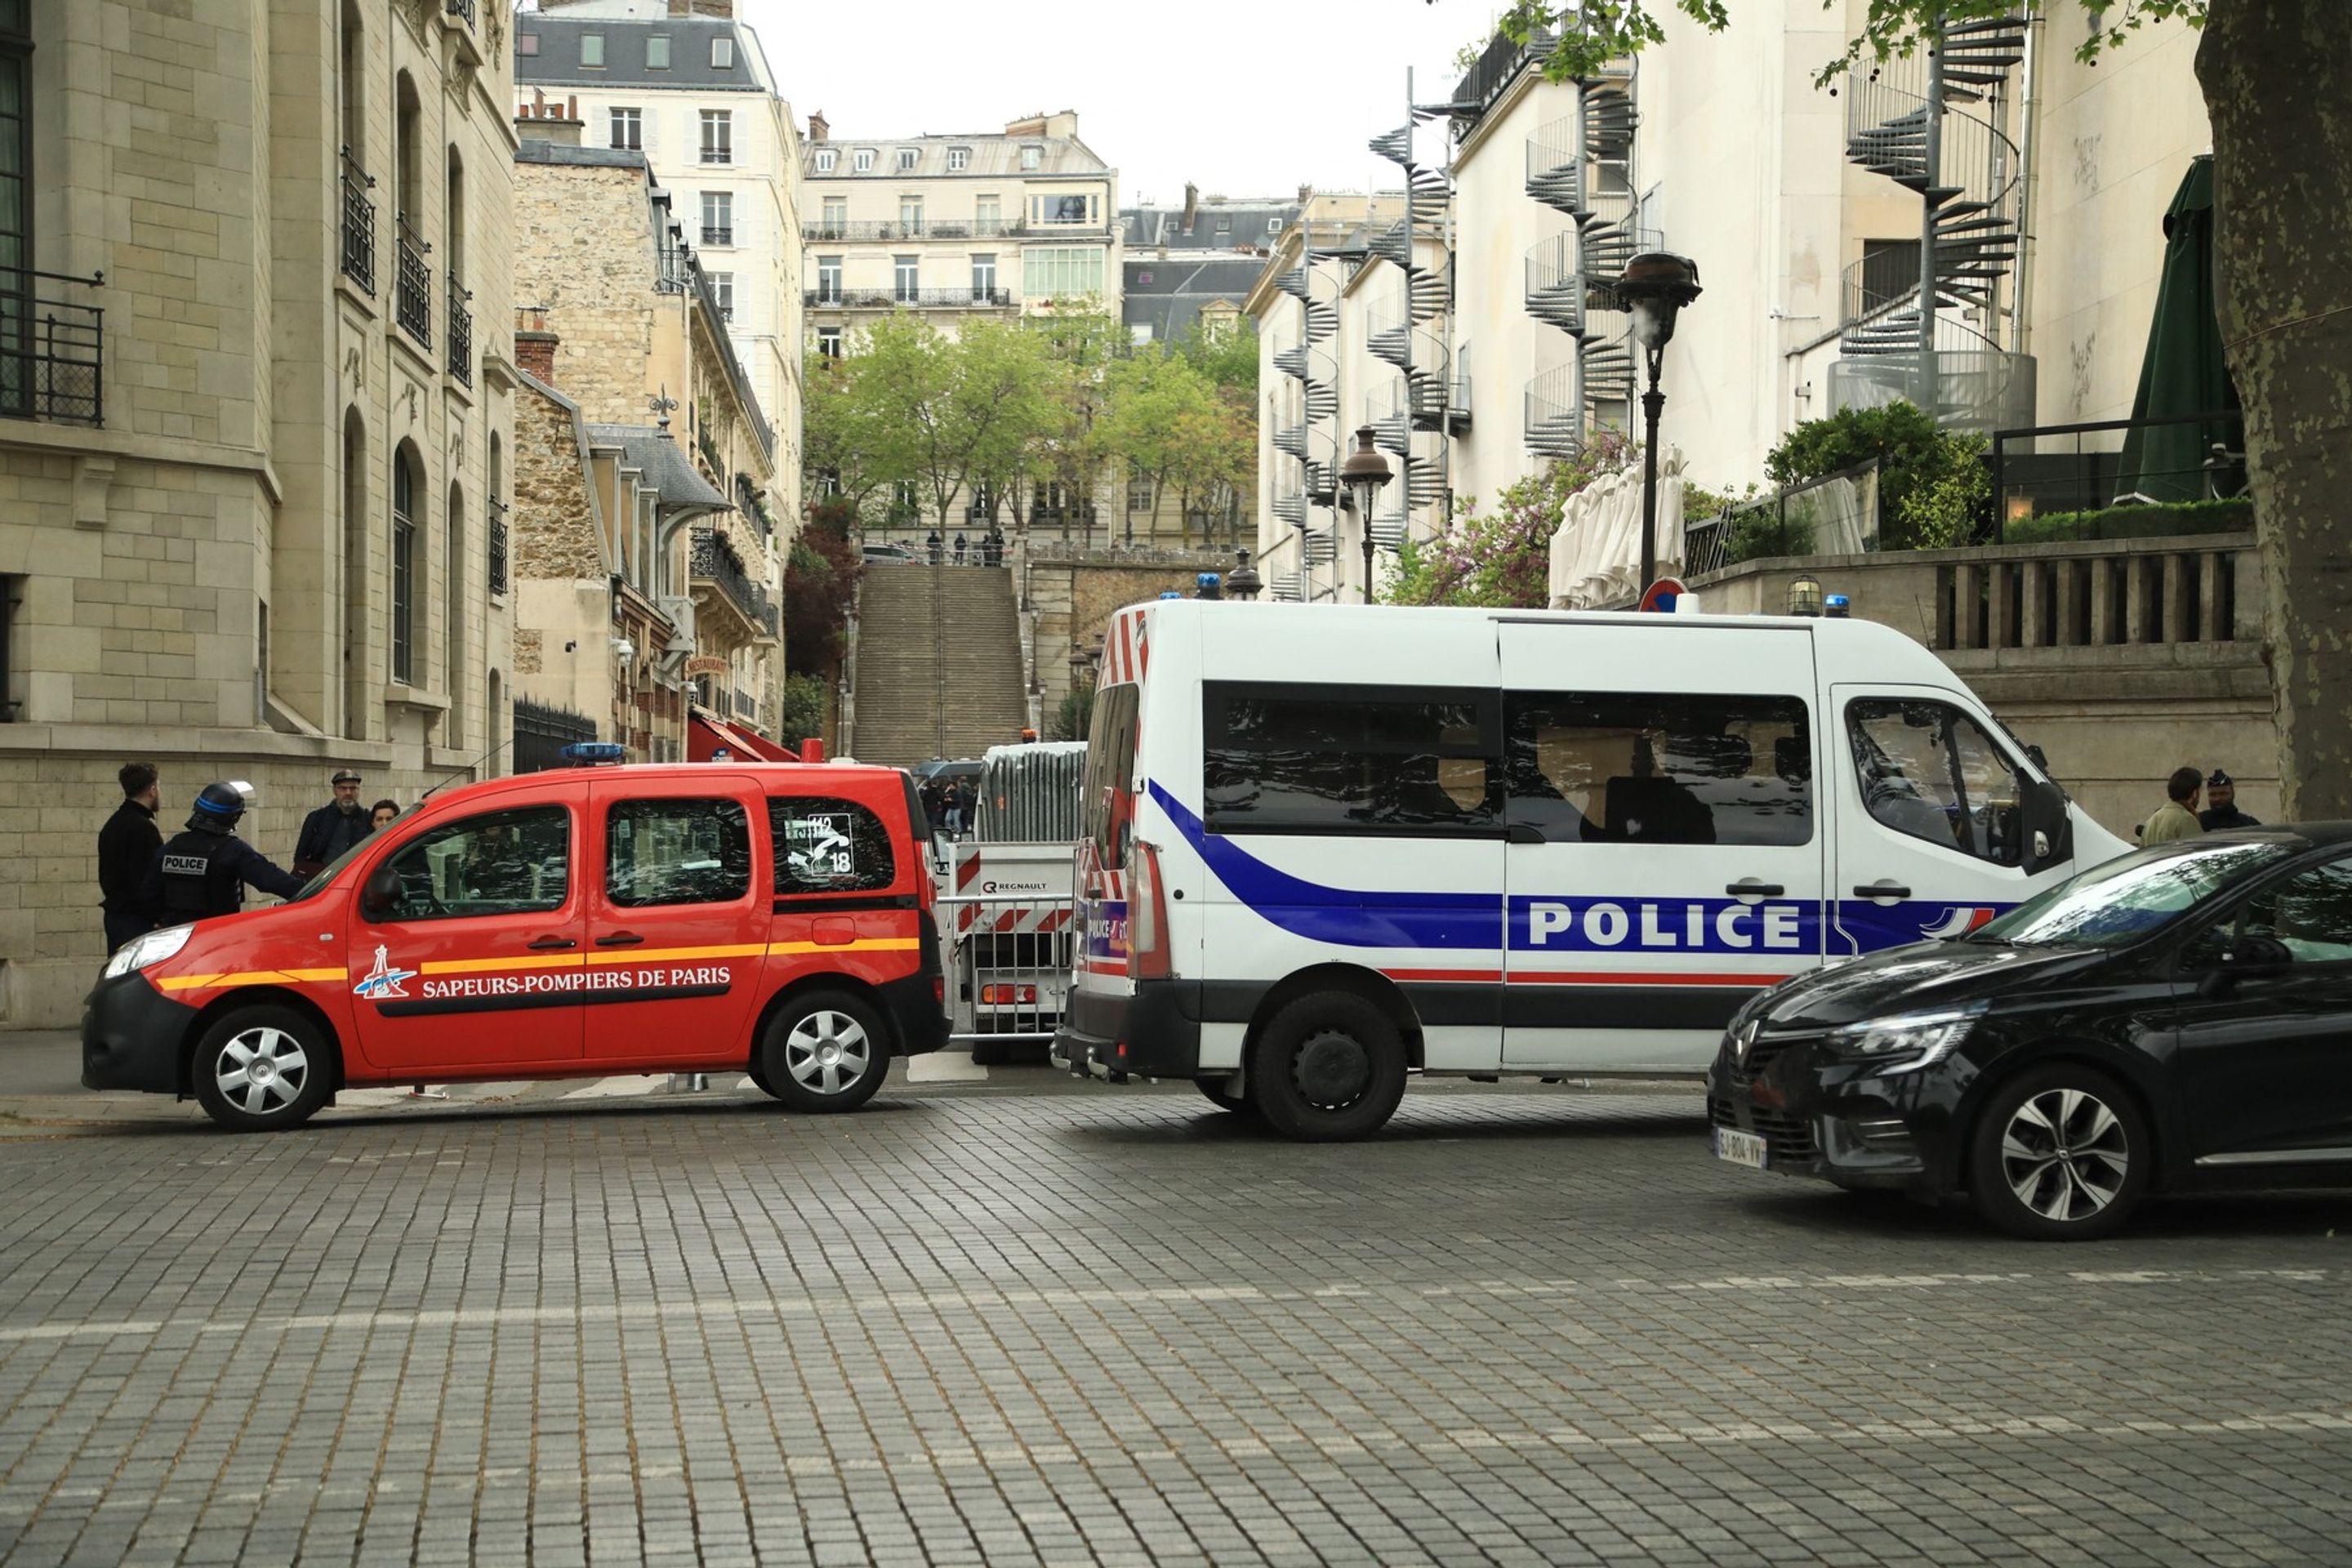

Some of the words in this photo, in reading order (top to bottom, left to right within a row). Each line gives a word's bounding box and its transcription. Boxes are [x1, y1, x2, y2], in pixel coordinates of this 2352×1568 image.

[810, 817, 831, 835] 112
[165, 858, 205, 869] POLICE
[830, 852, 851, 873] 18
[1089, 920, 1110, 939] POLICE
[1529, 902, 1801, 948] POLICE
[422, 971, 633, 999] SAPEURS-POMPIERS
[638, 969, 666, 987] DE
[670, 967, 730, 986] PARIS
